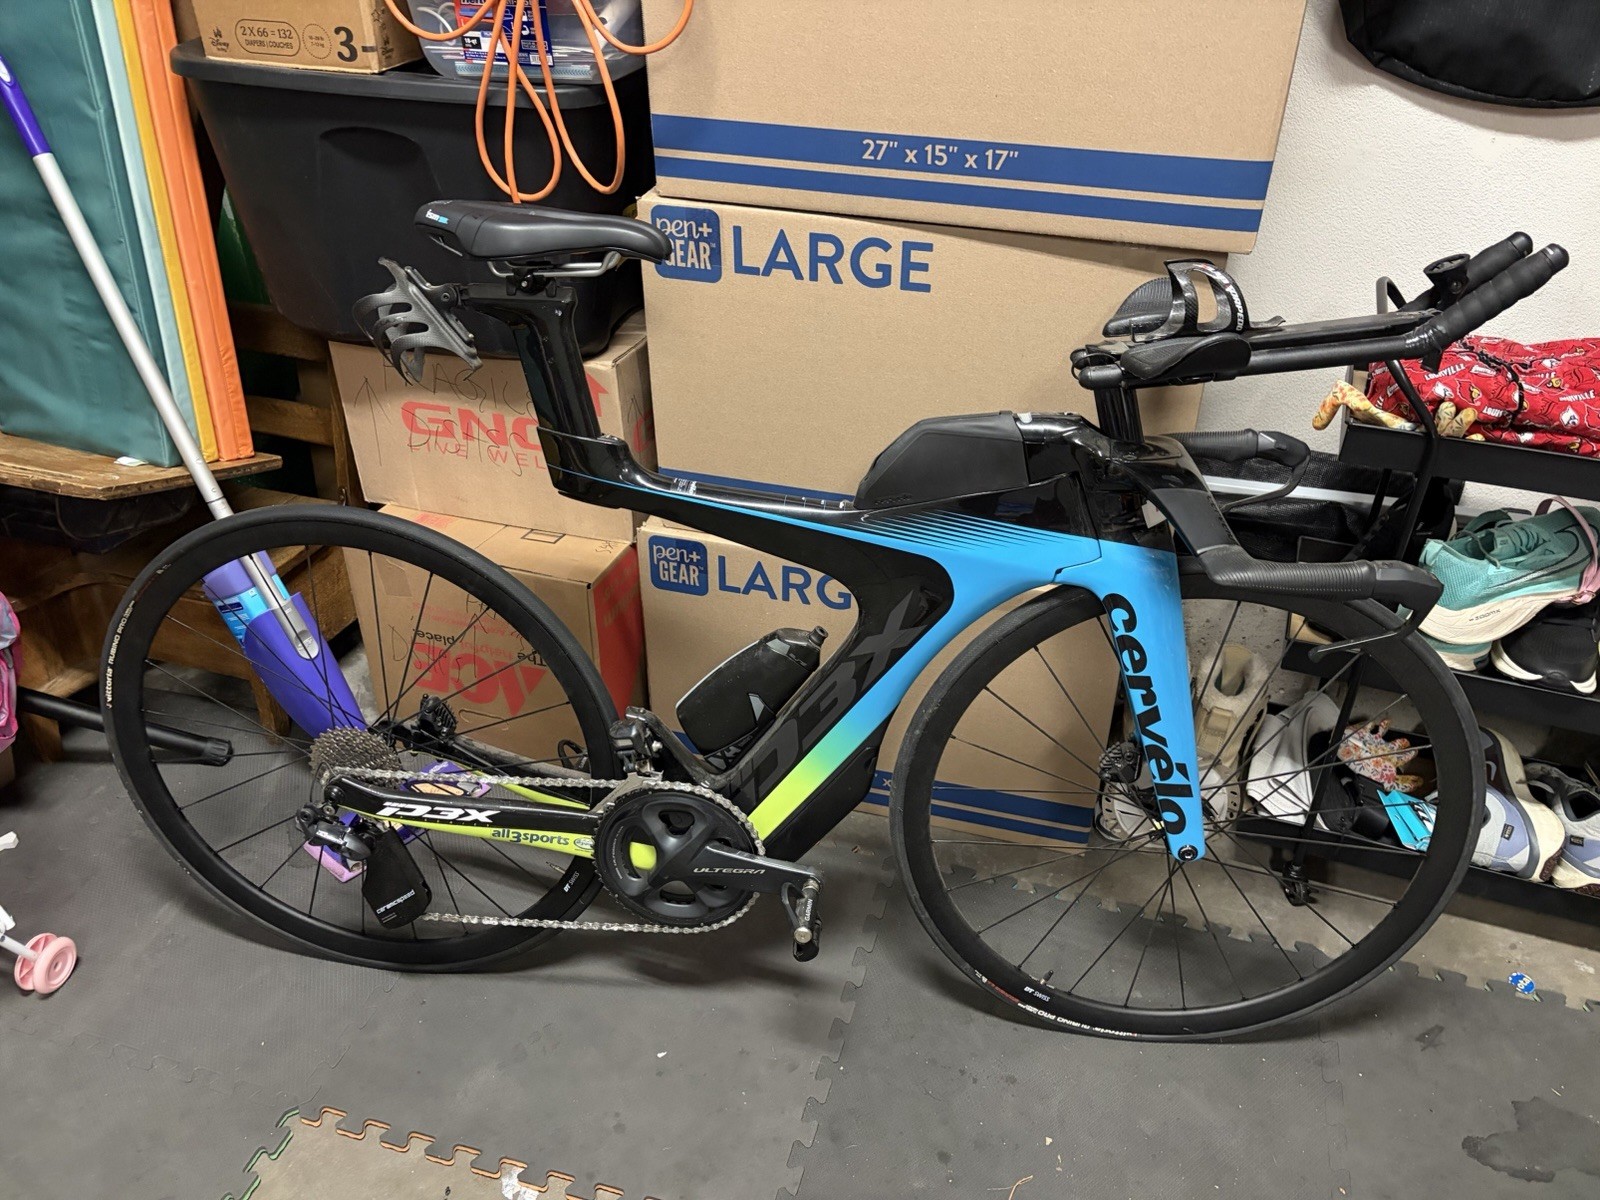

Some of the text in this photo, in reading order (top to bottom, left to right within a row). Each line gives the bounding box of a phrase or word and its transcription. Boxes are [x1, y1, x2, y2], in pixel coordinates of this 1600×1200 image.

[240, 26, 247, 36] 2
[257, 27, 269, 38] 66
[277, 28, 294, 40] 132
[862, 139, 1019, 171] 27" x 15" x 17"
[732, 225, 934, 293] LARGE
[489, 447, 546, 471] WEL
[653, 544, 701, 565] pen+
[659, 560, 700, 587] GEAR
[718, 555, 852, 610] LARG
[105, 666, 114, 702] vittoria
[412, 642, 549, 717] ACE
[1101, 592, 1194, 836] cervélo
[693, 867, 766, 875] ULTEGRA
[804, 899, 814, 922] GARMIN
